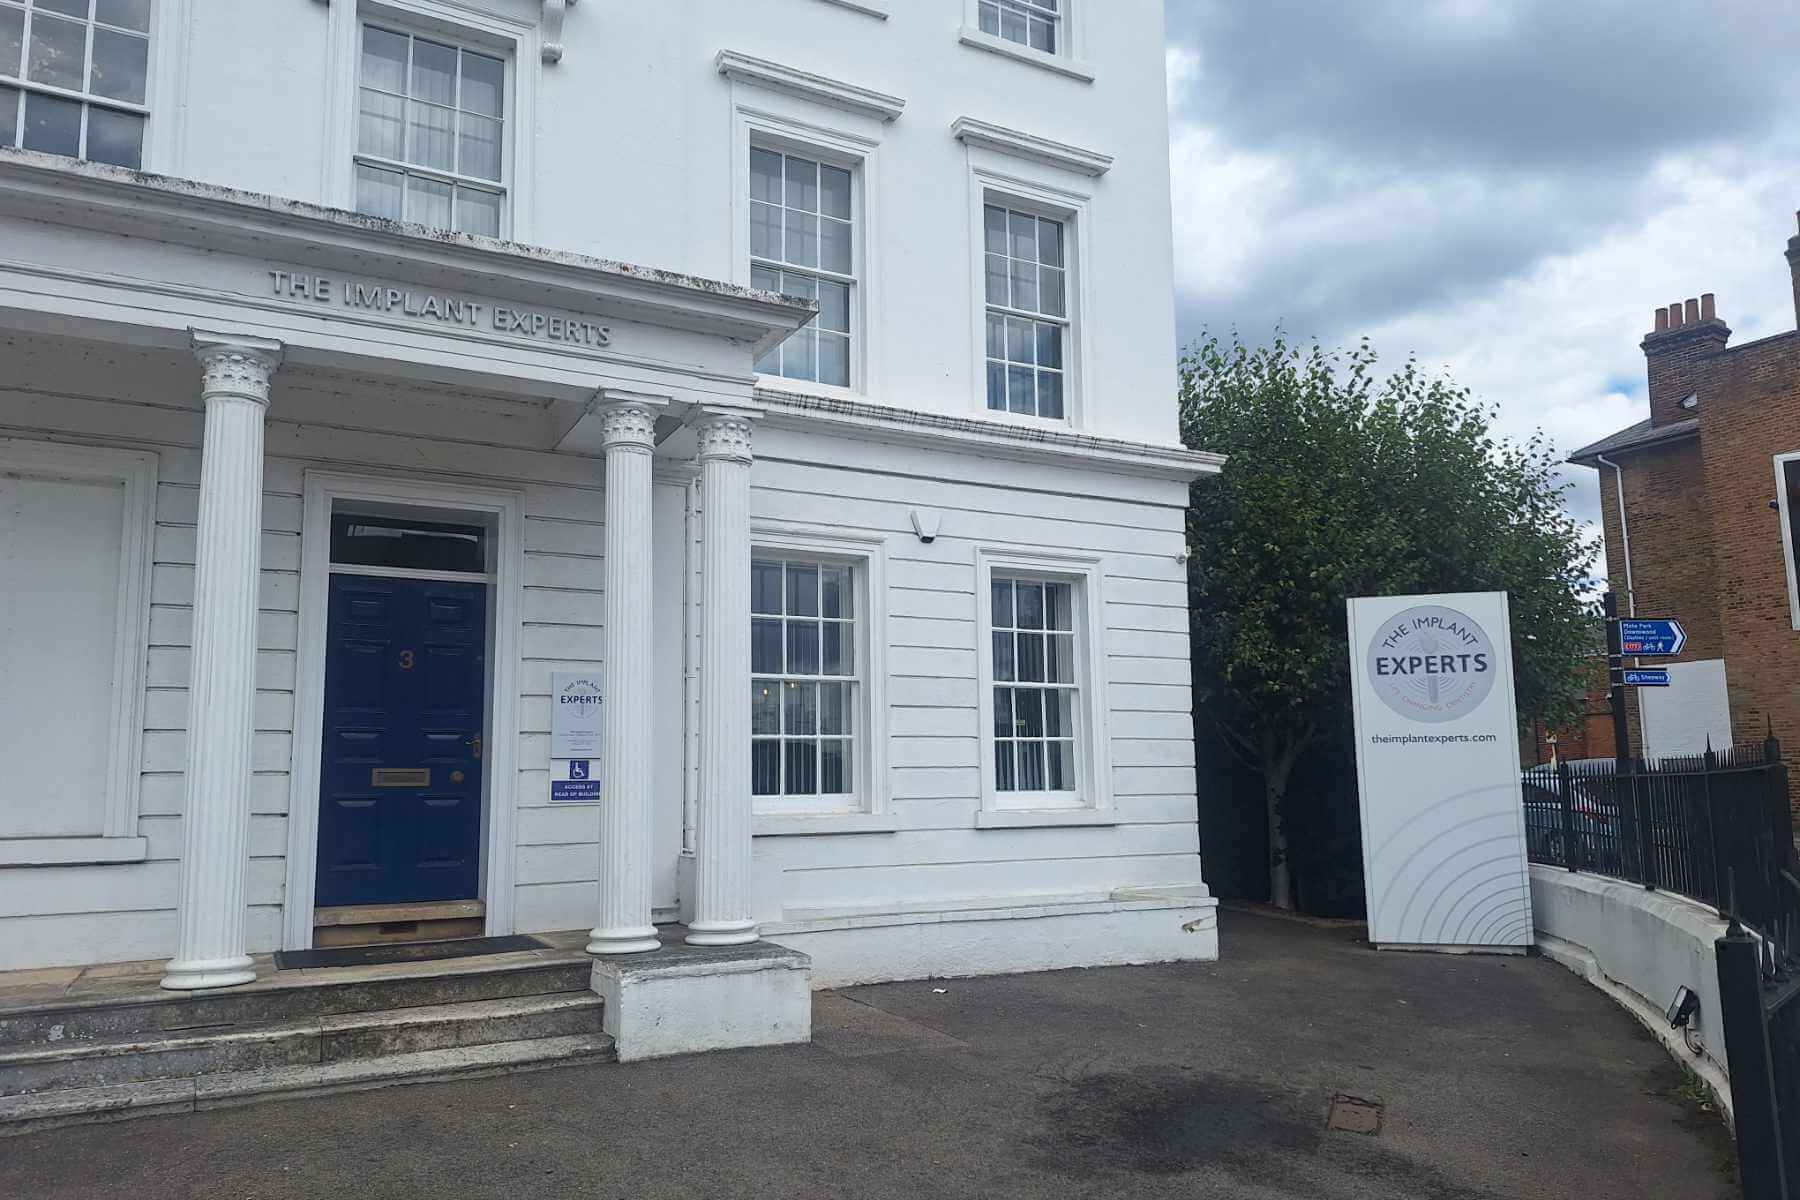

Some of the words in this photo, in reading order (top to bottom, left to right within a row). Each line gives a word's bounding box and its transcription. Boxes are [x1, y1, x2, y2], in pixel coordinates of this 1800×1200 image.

[269, 270, 330, 301] THE
[344, 281, 481, 325] IMPLANT
[494, 306, 610, 346] EXPERTS
[1382, 624, 1410, 649] THE
[1412, 617, 1479, 646] IMPLANT
[399, 650, 414, 669] 3
[1376, 653, 1488, 676] EXPERTS
[561, 695, 603, 704] EXPERTS
[1371, 733, 1497, 746] theimplantexperts.com
